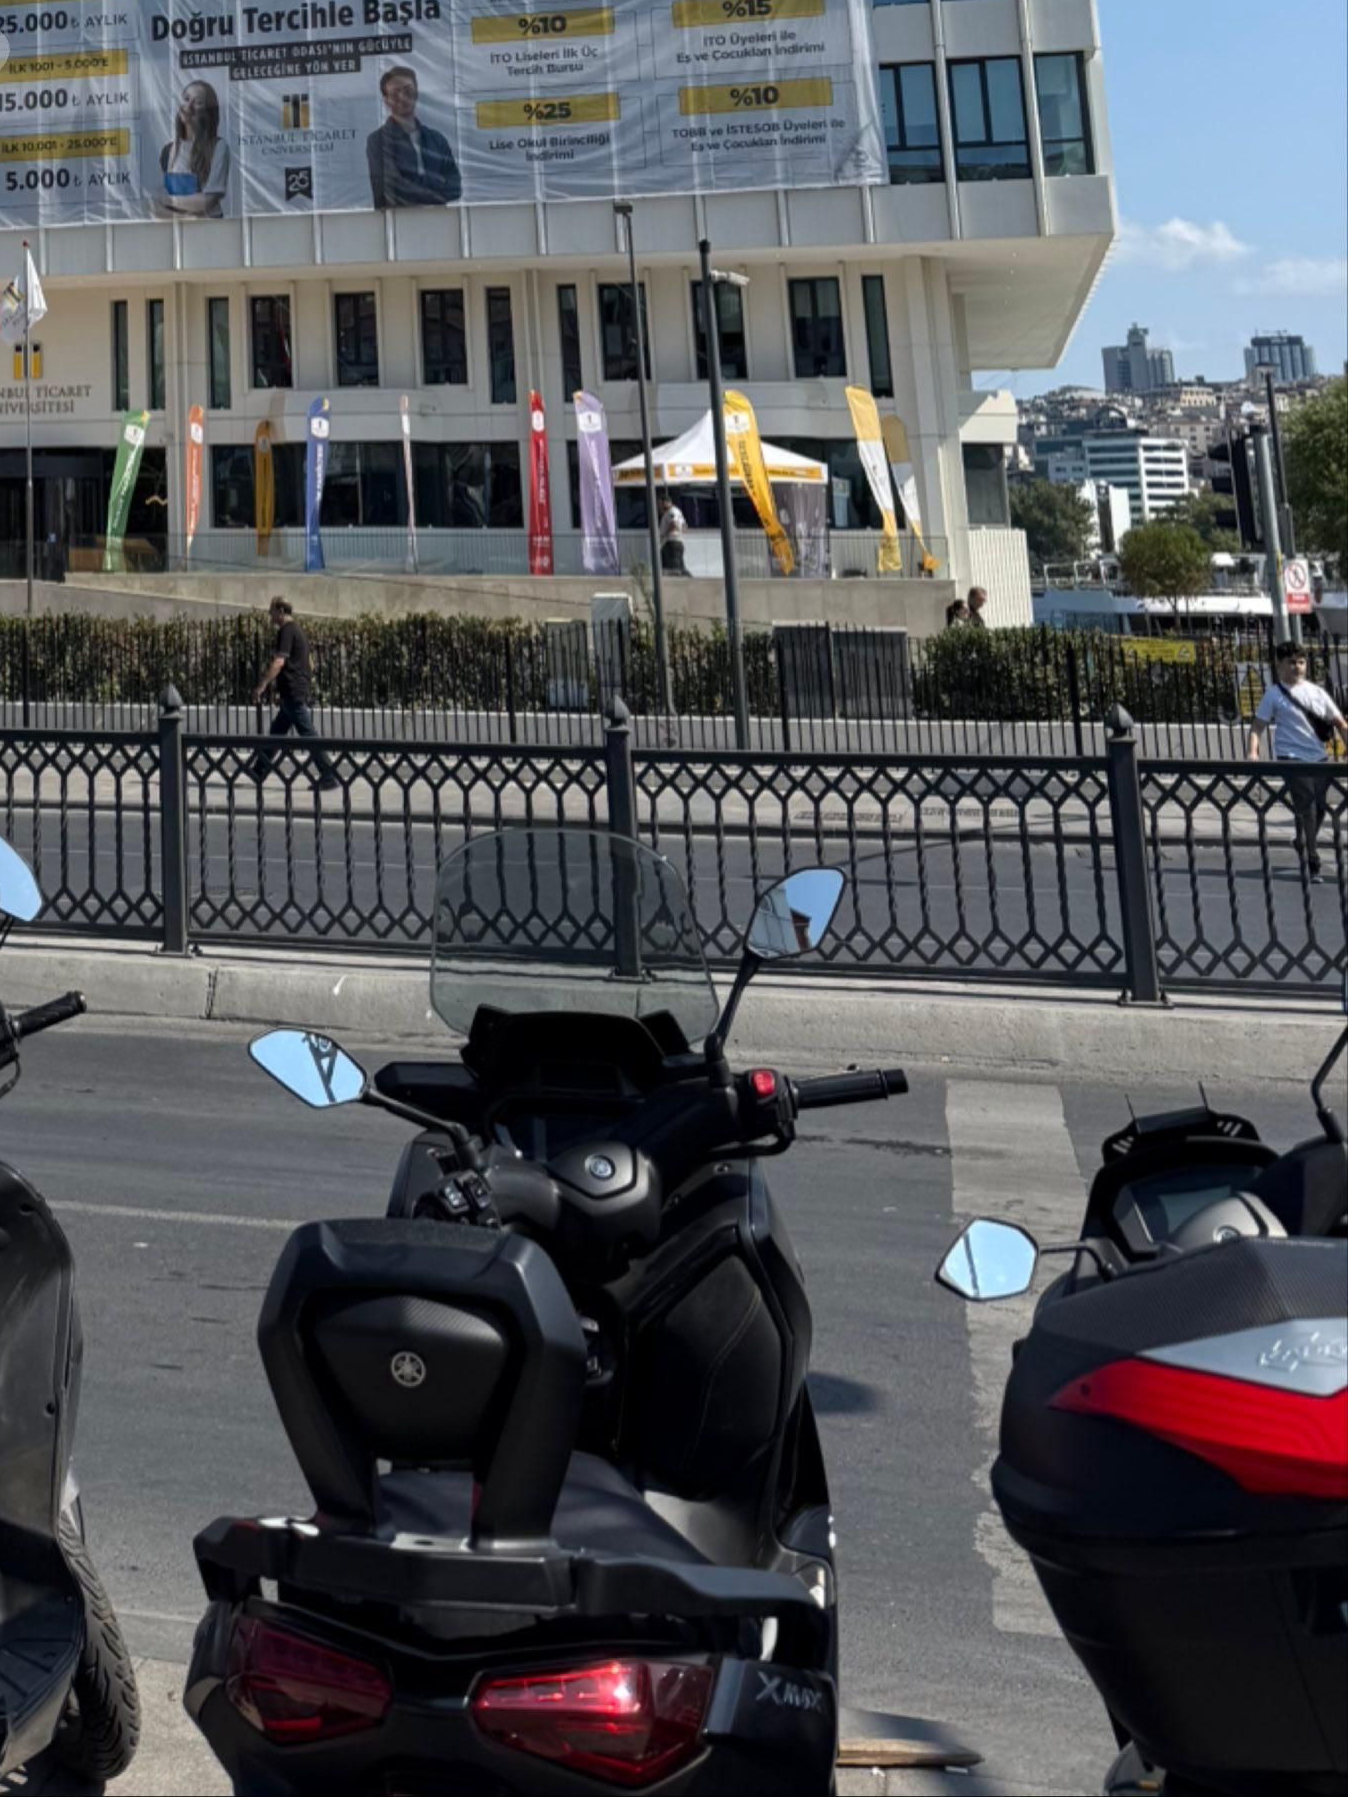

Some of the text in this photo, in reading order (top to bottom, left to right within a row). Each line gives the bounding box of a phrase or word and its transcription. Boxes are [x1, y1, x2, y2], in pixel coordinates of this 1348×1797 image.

[84, 13, 128, 28] AYLIK
[152, 12, 234, 43] Doğru
[243, 0, 354, 34] Tercihle
[518, 14, 567, 36] %10
[182, 36, 411, 67] İSTANBUL TİCARET ODASI'NIN GÜCÜYLE
[232, 58, 356, 79] GELECEĞİNE YÖN VER
[507, 62, 584, 77] Tercih Bursu
[86, 92, 130, 107] AYLIK
[730, 85, 780, 107] %10
[523, 101, 572, 122] %25
[5, 168, 70, 192] 5.000
[88, 171, 131, 187] AYLIK
[35, 384, 92, 399] TİCARET
